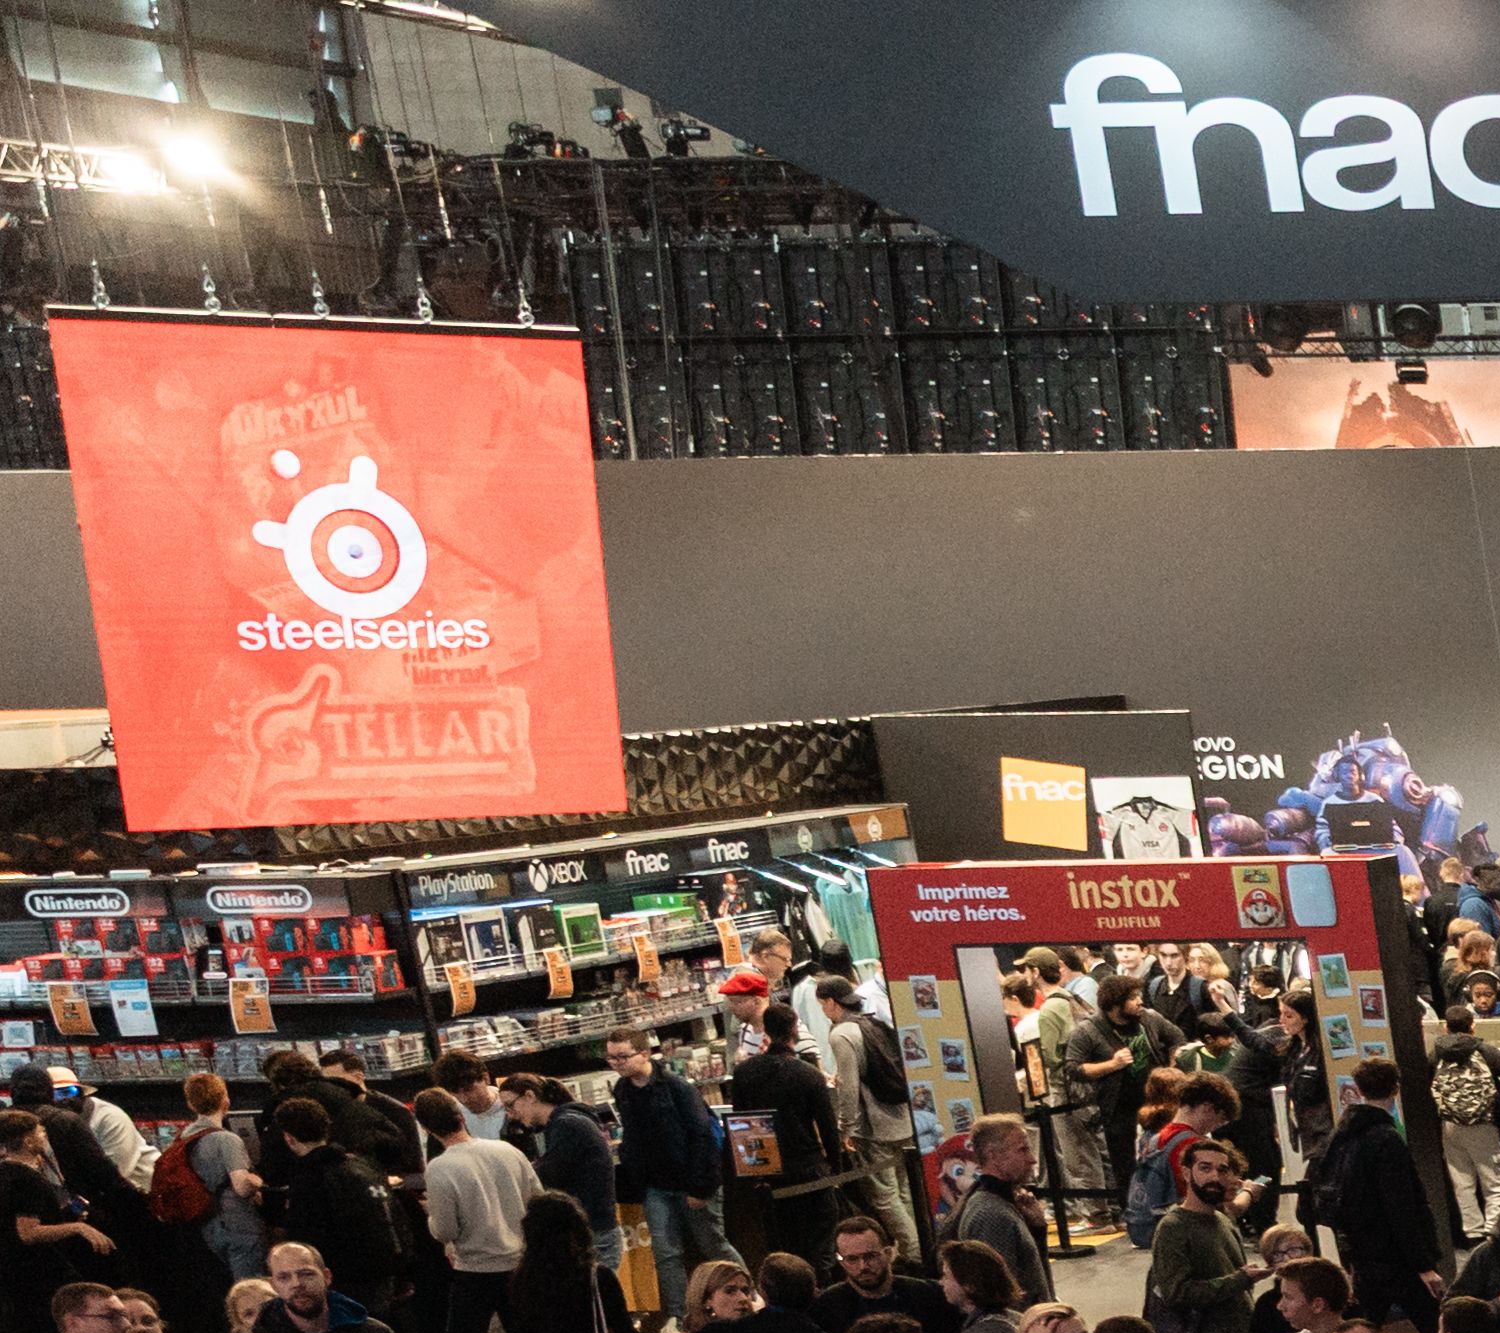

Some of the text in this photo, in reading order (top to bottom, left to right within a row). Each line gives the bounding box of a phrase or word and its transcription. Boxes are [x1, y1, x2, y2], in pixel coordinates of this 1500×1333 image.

[237, 611, 490, 651] steelseries
[1194, 737, 1235, 753] ovo
[1002, 773, 1086, 803] fnac
[708, 837, 749, 865] fnac
[1141, 839, 1161, 849] VISA
[550, 858, 587, 884] XBOX
[625, 848, 670, 877] fnac
[419, 870, 496, 899] PlayStation
[917, 884, 1009, 903] Imprimez
[1069, 872, 1180, 910] instax
[34, 895, 121, 912] Nintendo
[215, 892, 303, 910] Nintendo
[911, 904, 1027, 922] votre héros.
[1096, 915, 1162, 929] FUJIFILM
